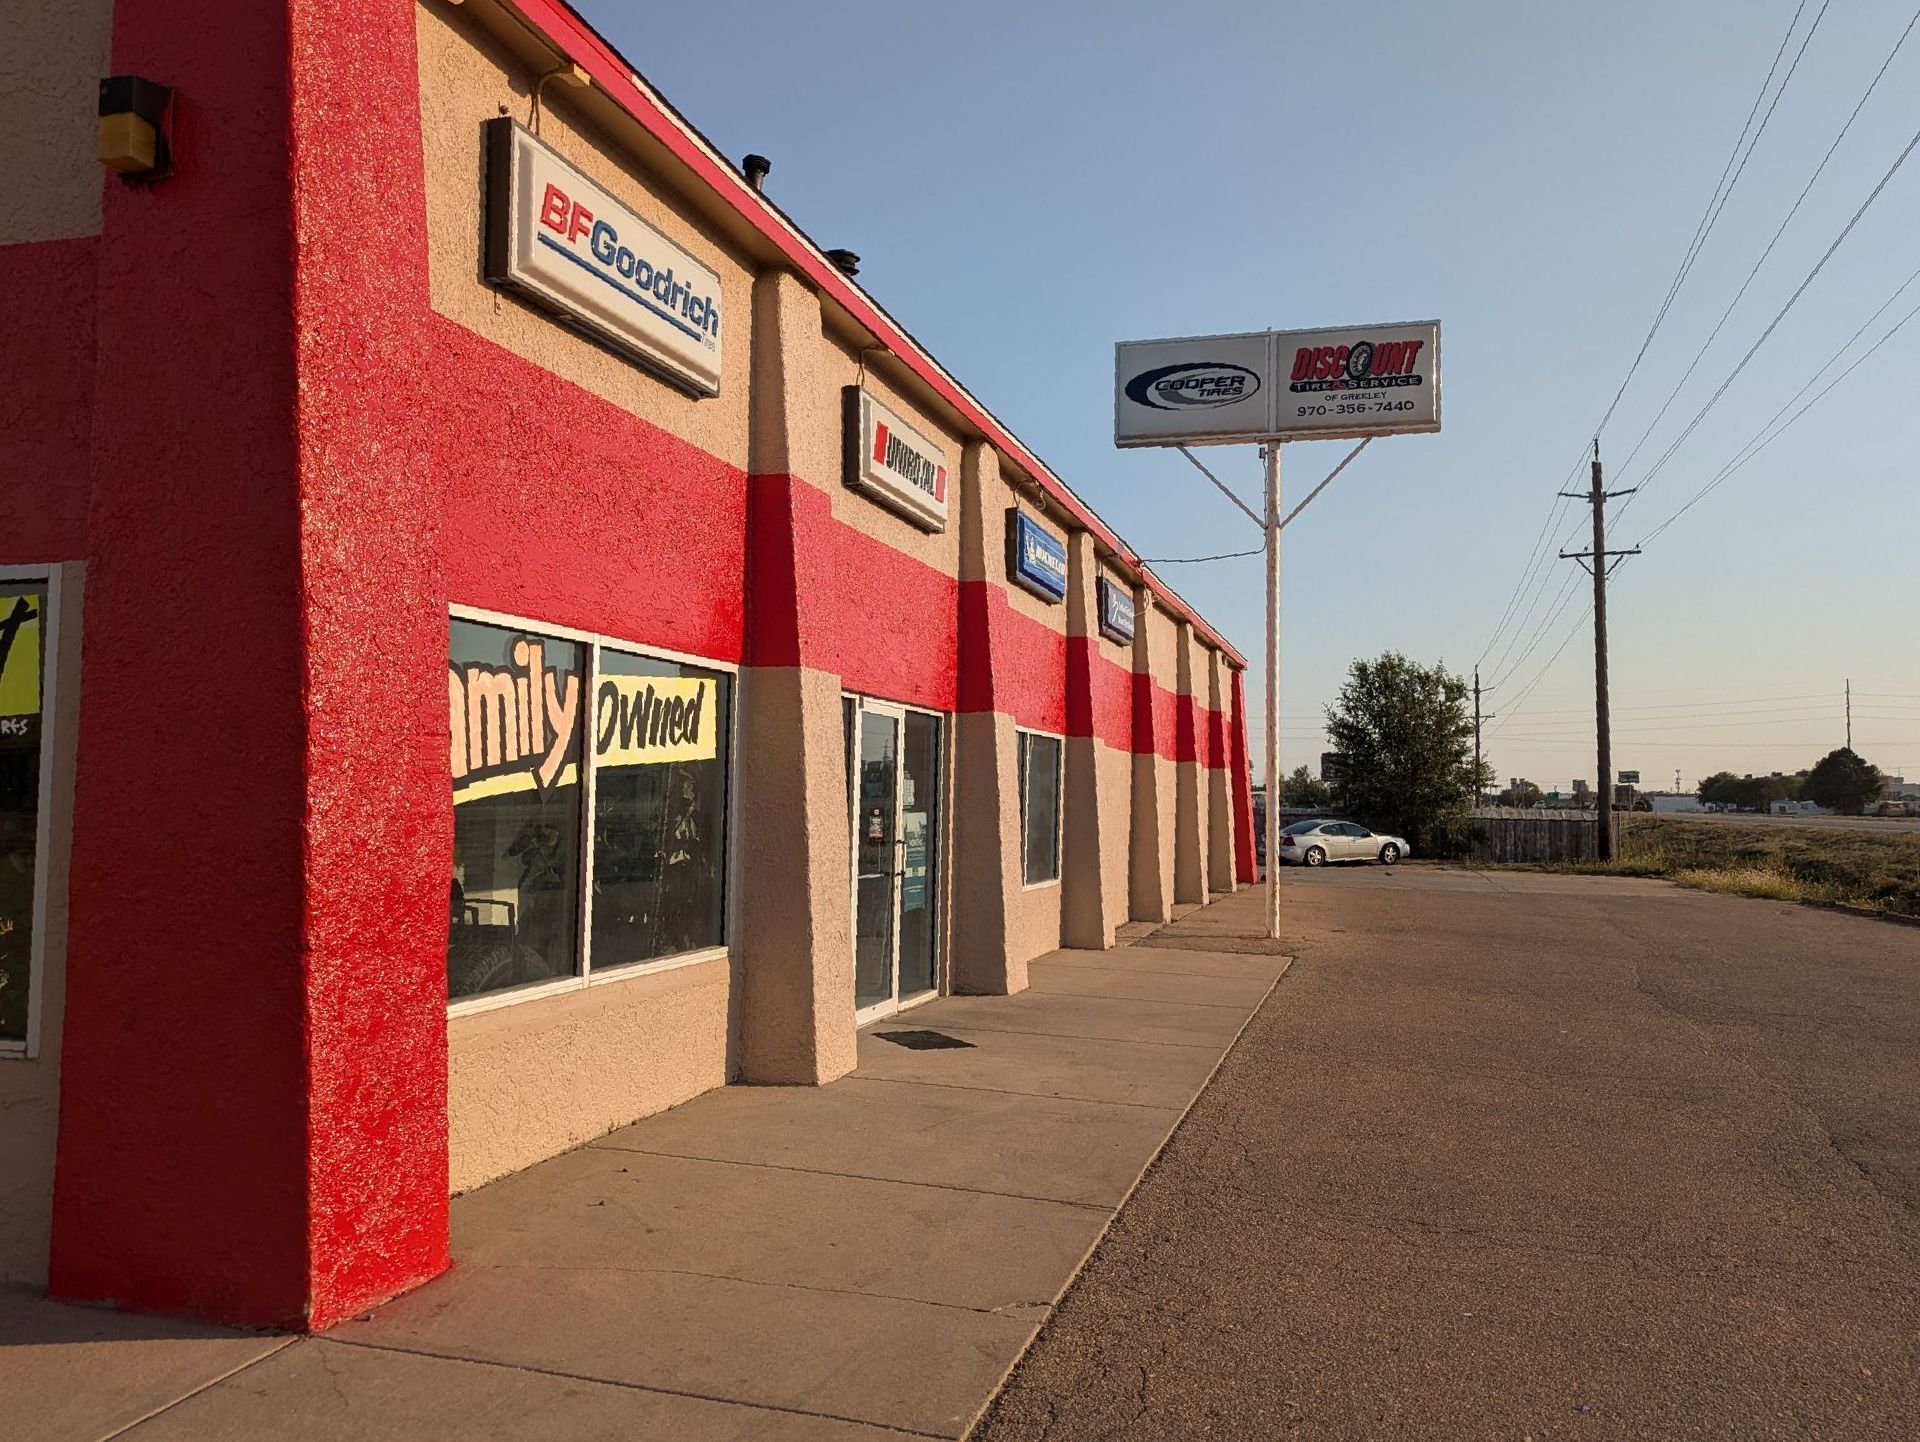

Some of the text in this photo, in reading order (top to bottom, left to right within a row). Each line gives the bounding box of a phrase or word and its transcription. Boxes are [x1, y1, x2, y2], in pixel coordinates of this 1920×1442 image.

[540, 182, 719, 338] BFGoodrich
[1290, 340, 1425, 381] DISCOUNT
[1154, 375, 1246, 392] COOPER
[1197, 386, 1244, 397] TIRES
[1296, 382, 1332, 393] TIRE
[1348, 377, 1420, 391] SERVICE
[1324, 391, 1388, 402] OF GREELEY
[1297, 400, 1416, 417] 970-356-7440
